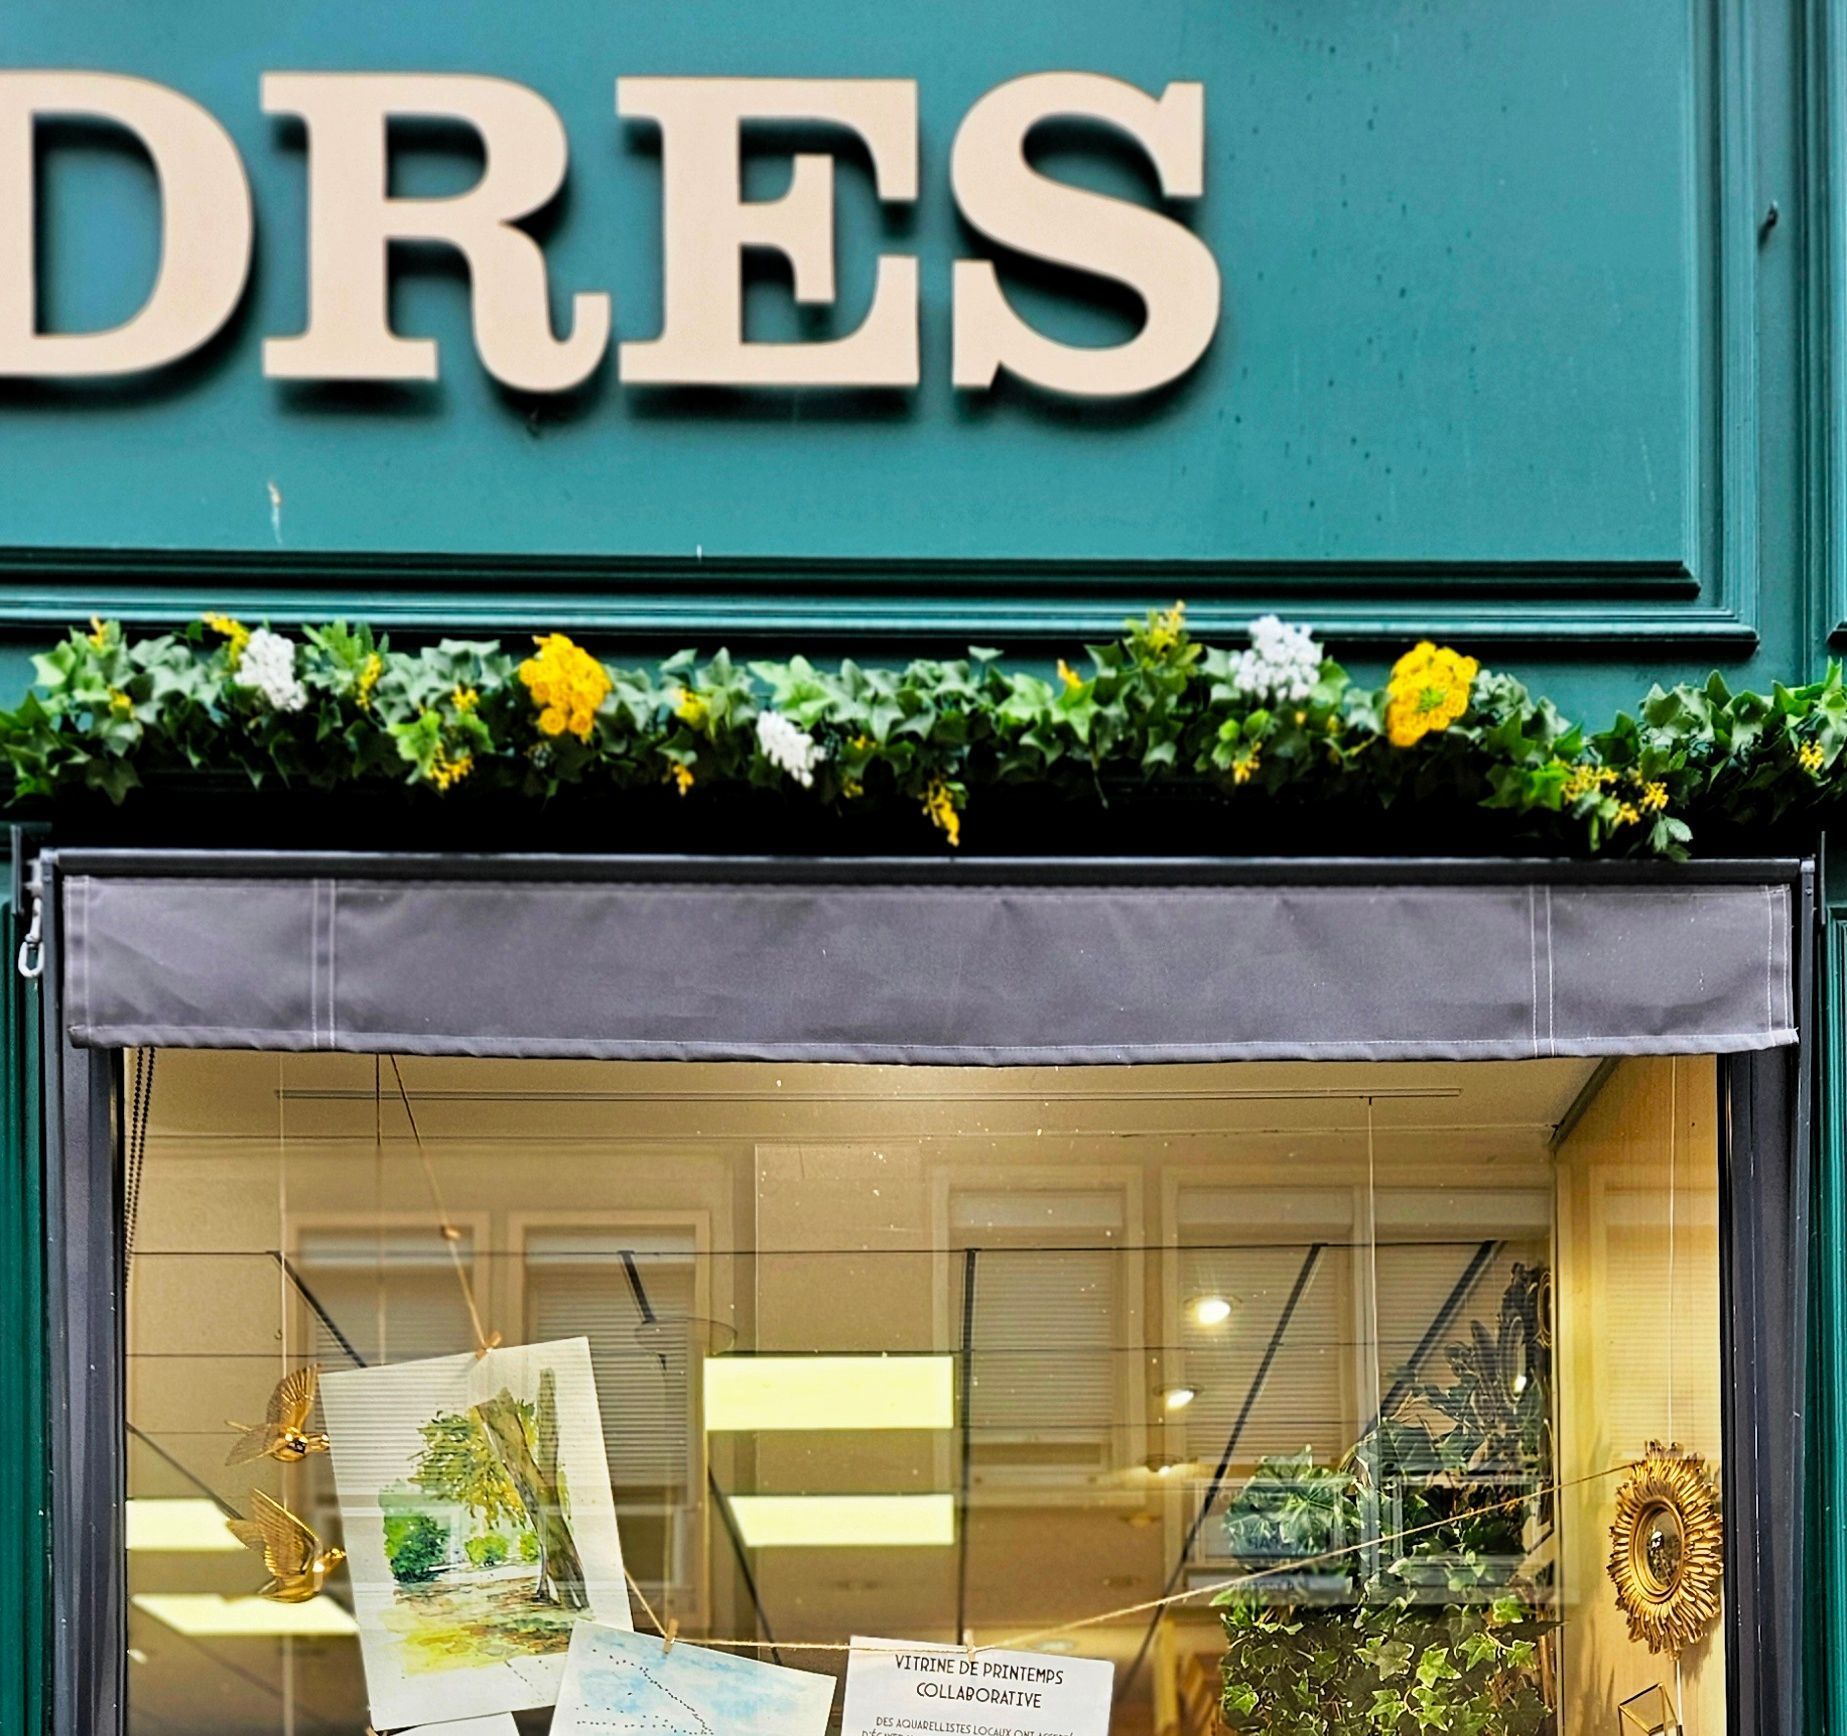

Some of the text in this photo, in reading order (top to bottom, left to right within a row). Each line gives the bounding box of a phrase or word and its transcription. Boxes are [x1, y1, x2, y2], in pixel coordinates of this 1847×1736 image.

[0, 70, 1220, 397] DRES
[895, 1654, 1064, 1685] VITRINE DE PRINTEMPS
[917, 1682, 1042, 1708] COLLABORATIVE
[876, 1716, 894, 1727] DES
[896, 1718, 971, 1734] AQUARELLISTES
